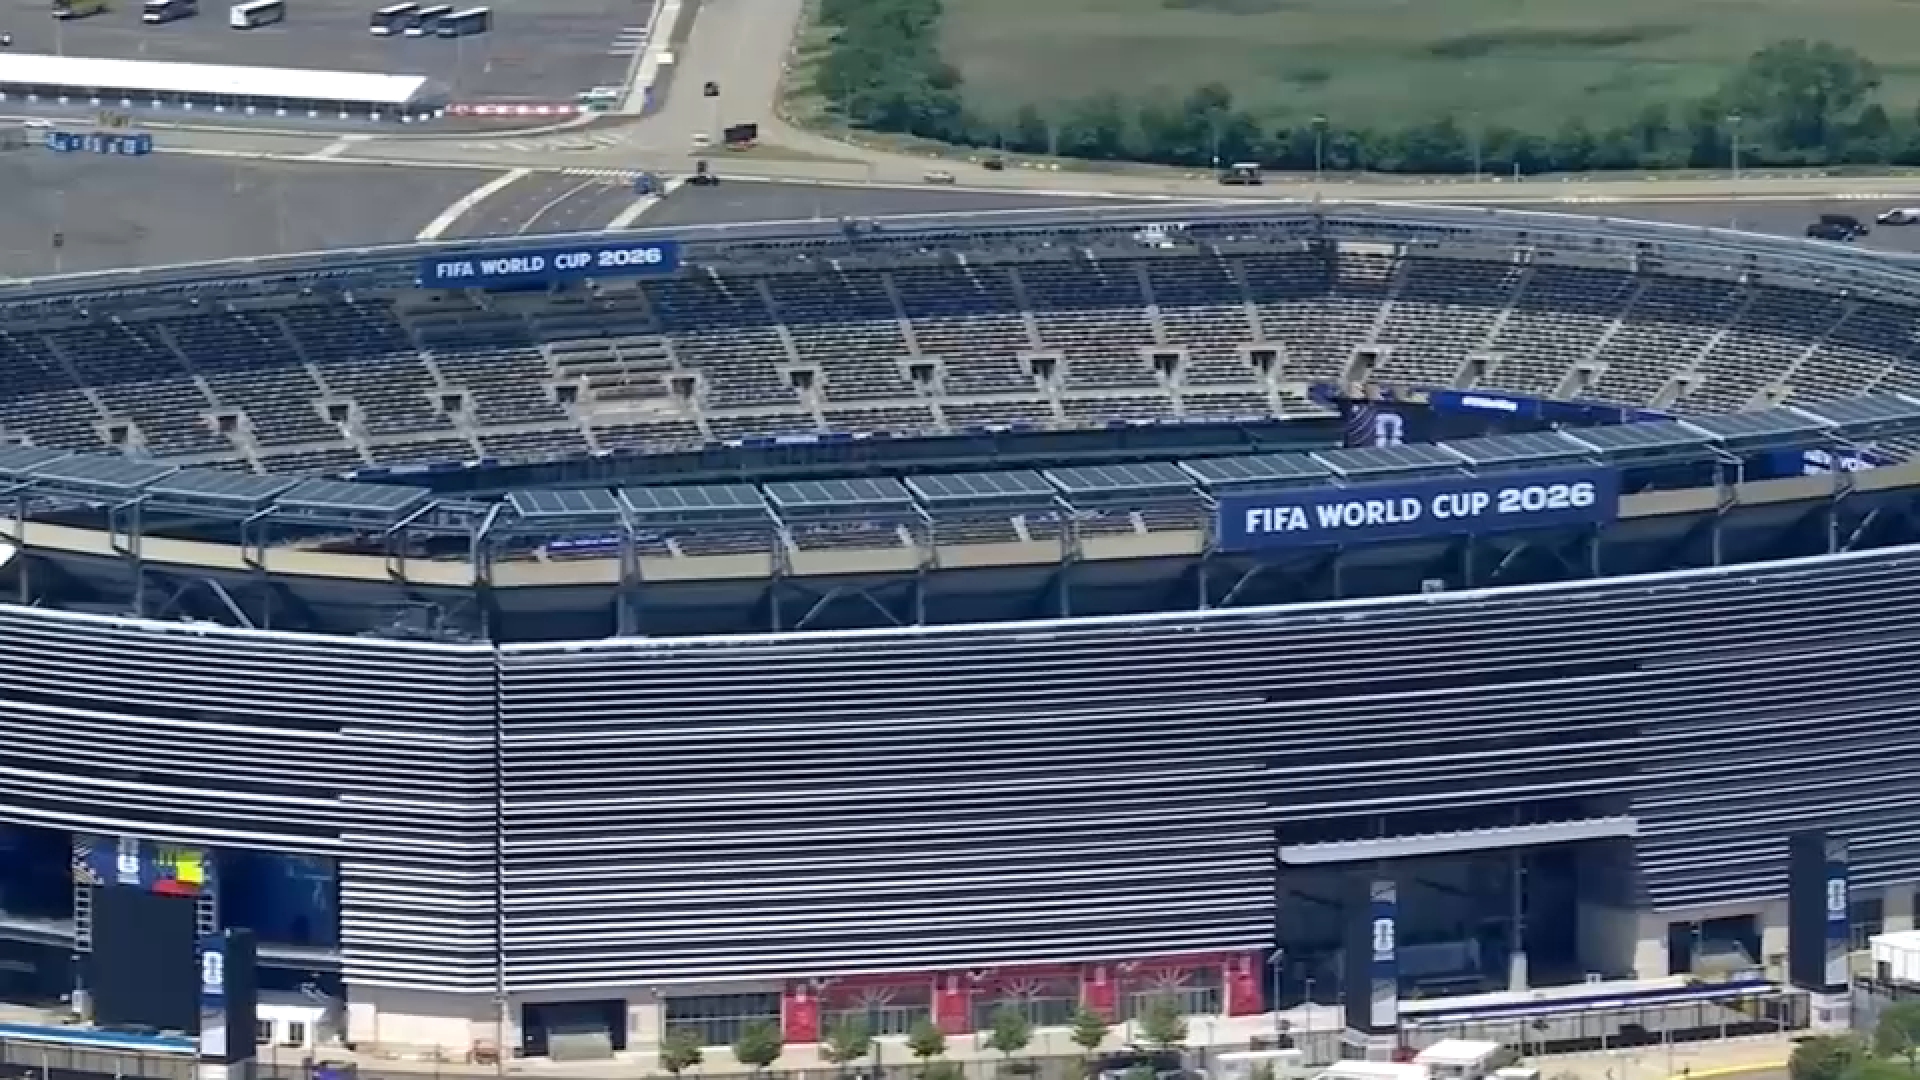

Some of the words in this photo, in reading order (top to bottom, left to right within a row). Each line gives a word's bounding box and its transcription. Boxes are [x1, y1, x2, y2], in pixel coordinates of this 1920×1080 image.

[437, 262, 474, 278] FIFA
[480, 257, 544, 274] WORLD
[554, 252, 592, 269] CUP
[598, 248, 661, 266] 2026
[1245, 507, 1309, 533] FIFA
[1315, 498, 1420, 529] WORLD
[1431, 492, 1490, 519] CUP
[1497, 482, 1595, 513] 2026
